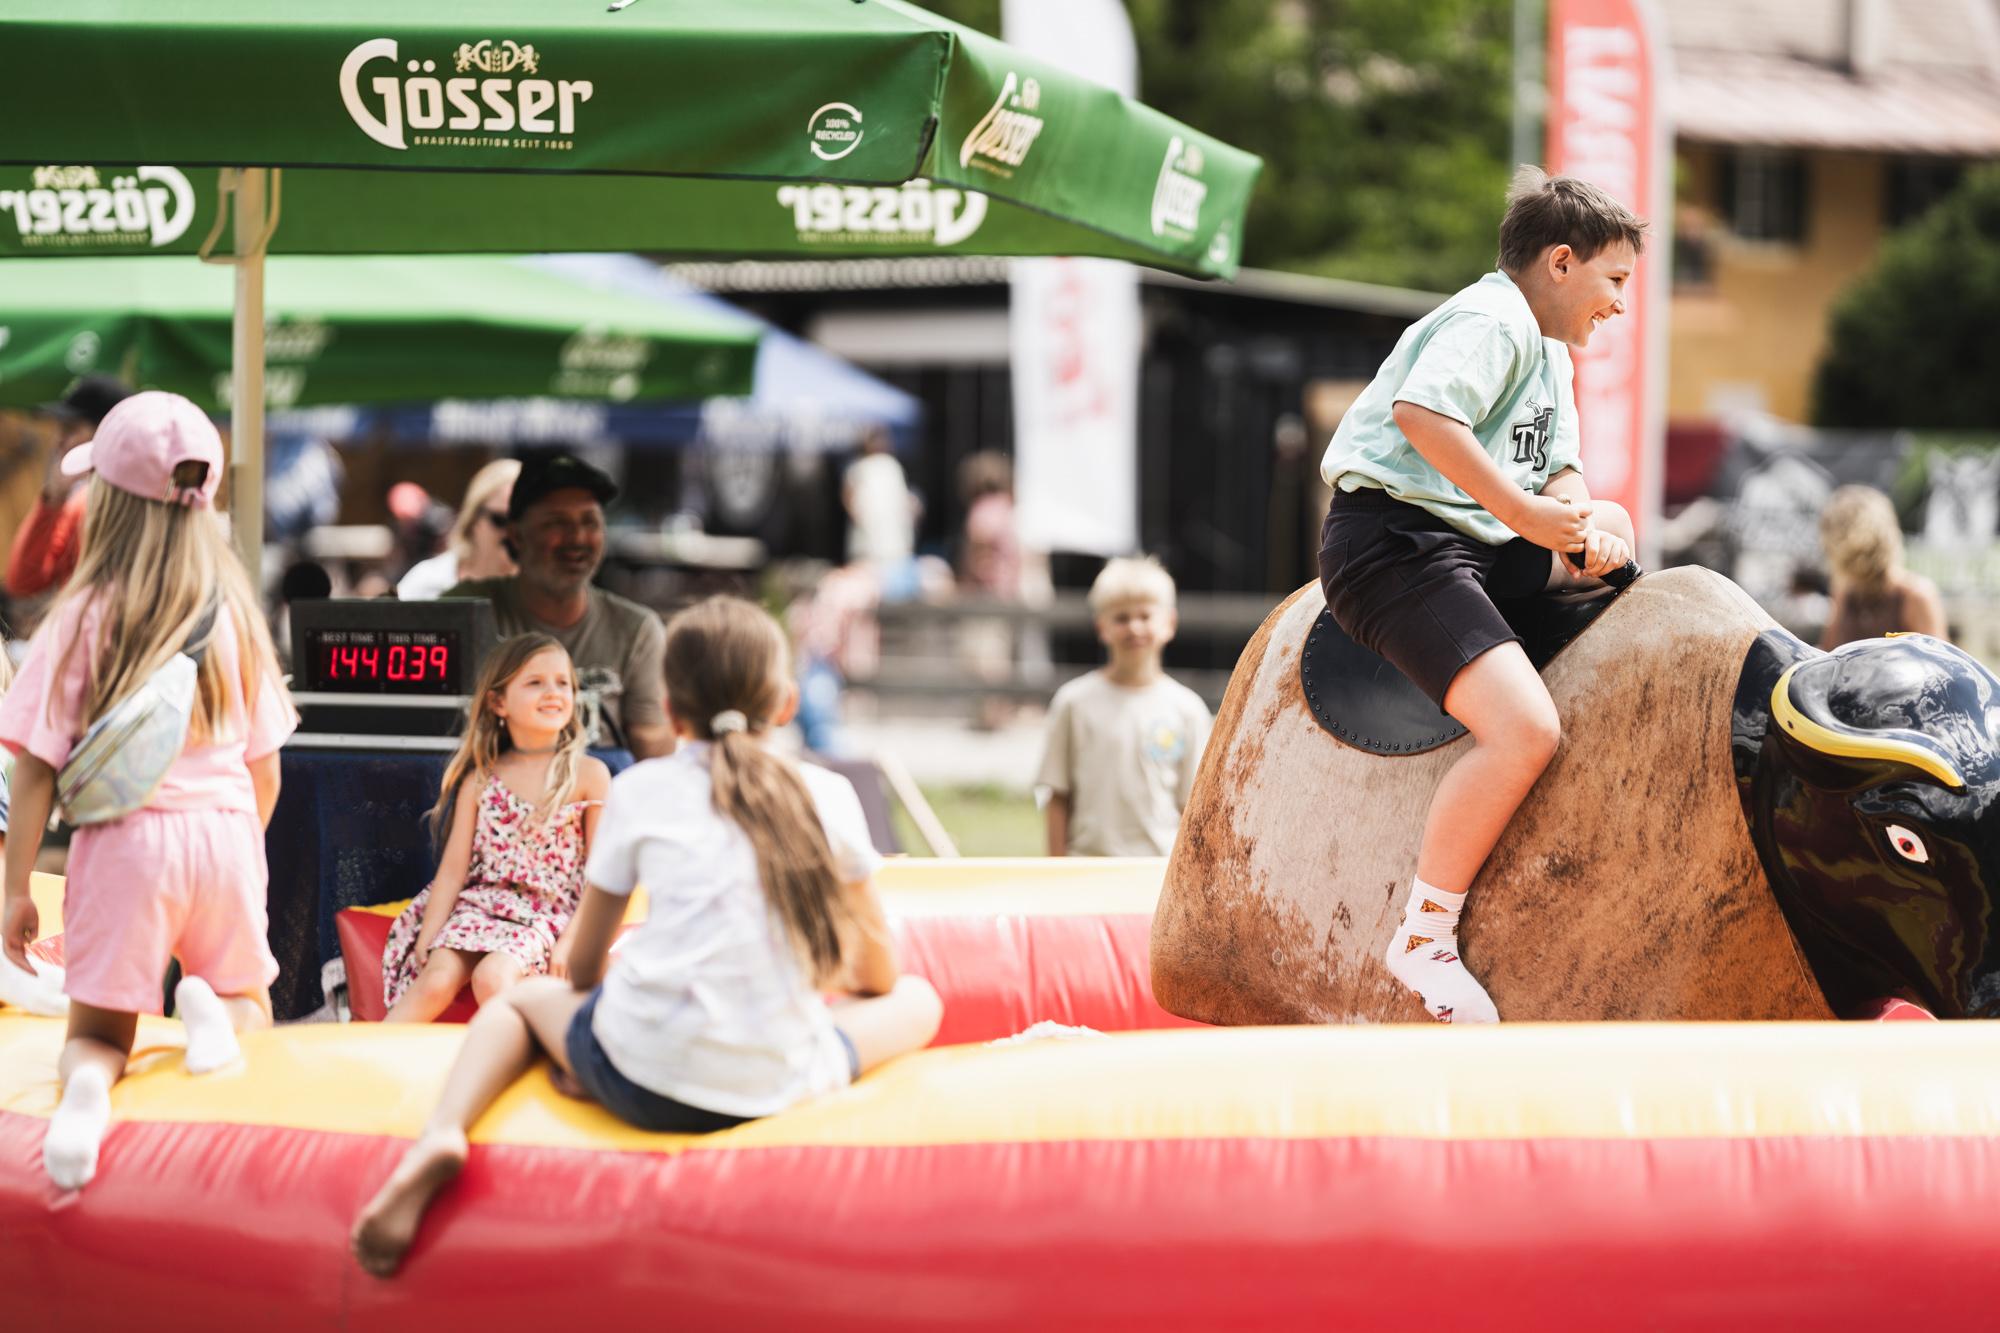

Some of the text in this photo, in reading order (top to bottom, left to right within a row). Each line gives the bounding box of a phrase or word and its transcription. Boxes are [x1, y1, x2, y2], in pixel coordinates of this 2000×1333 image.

[339, 38, 594, 150] Gösser
[825, 118, 849, 129] 100%
[815, 130, 857, 141] RECYCLED
[414, 136, 509, 147] BRAUTRADITION
[513, 139, 540, 149] SEIT
